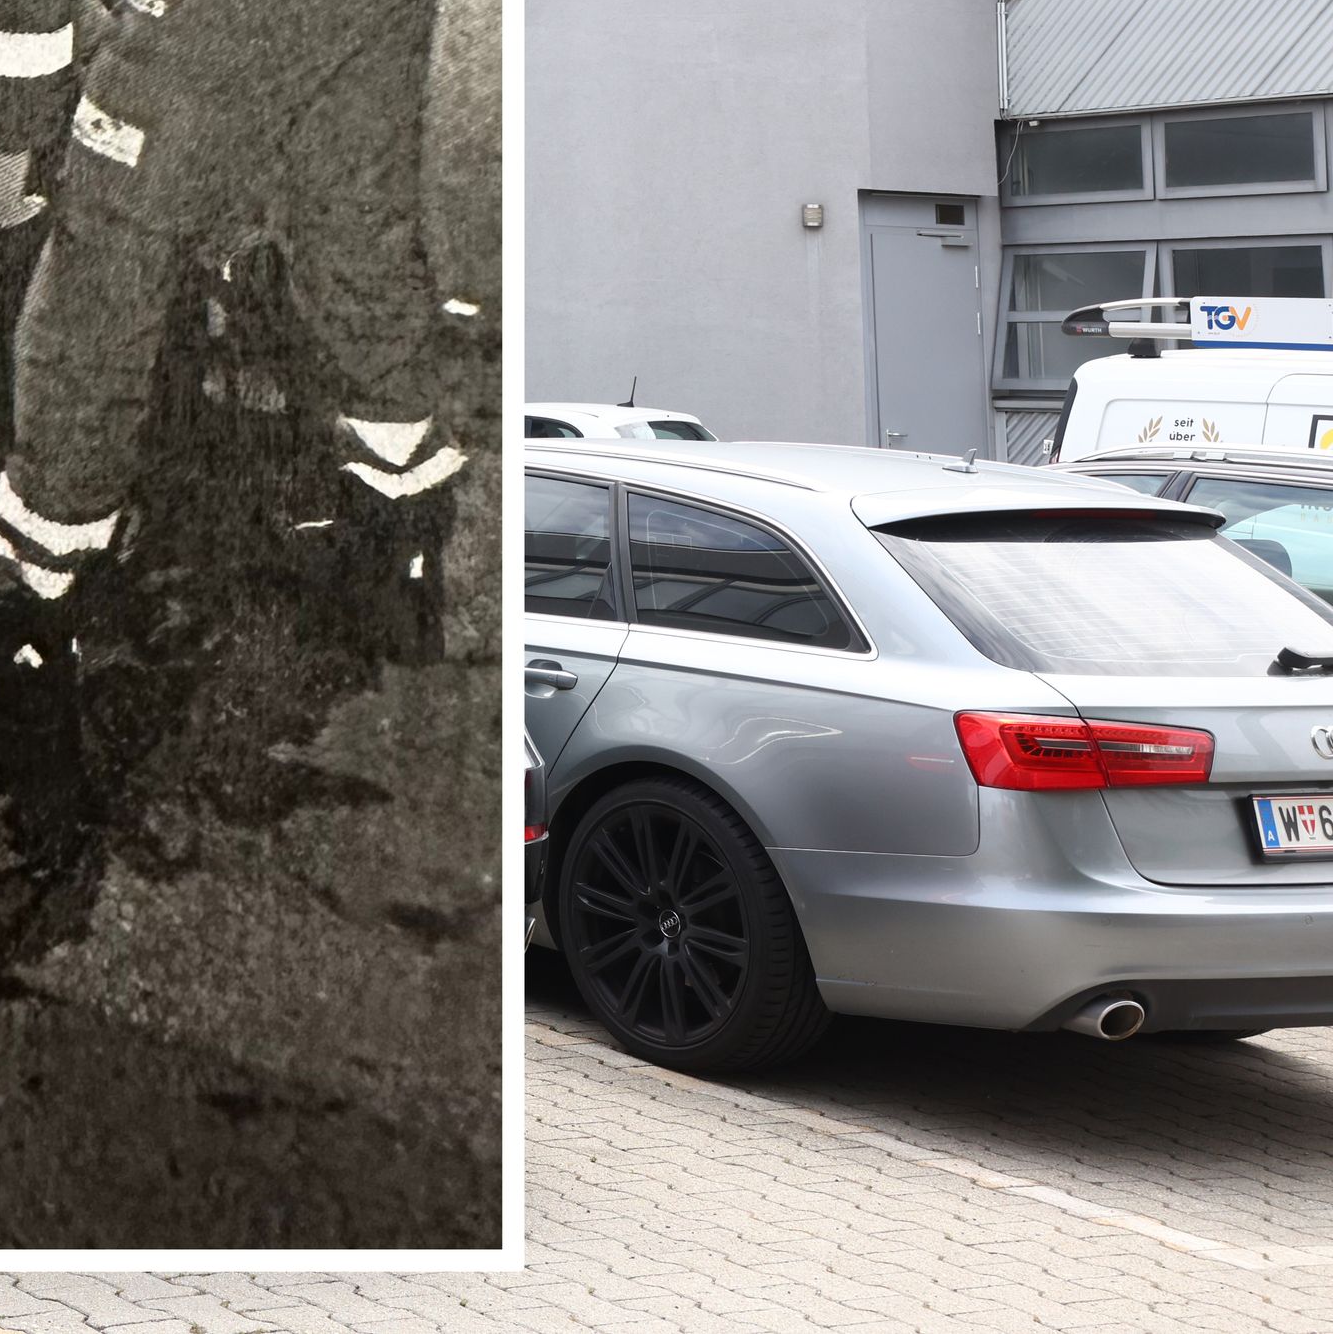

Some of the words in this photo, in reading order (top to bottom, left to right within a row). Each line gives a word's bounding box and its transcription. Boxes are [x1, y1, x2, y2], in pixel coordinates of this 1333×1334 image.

[1199, 305, 1252, 331] TGV
[1174, 417, 1194, 428] seit
[1169, 431, 1196, 442] über
[1278, 806, 1300, 842] W
[1268, 830, 1275, 841] A
